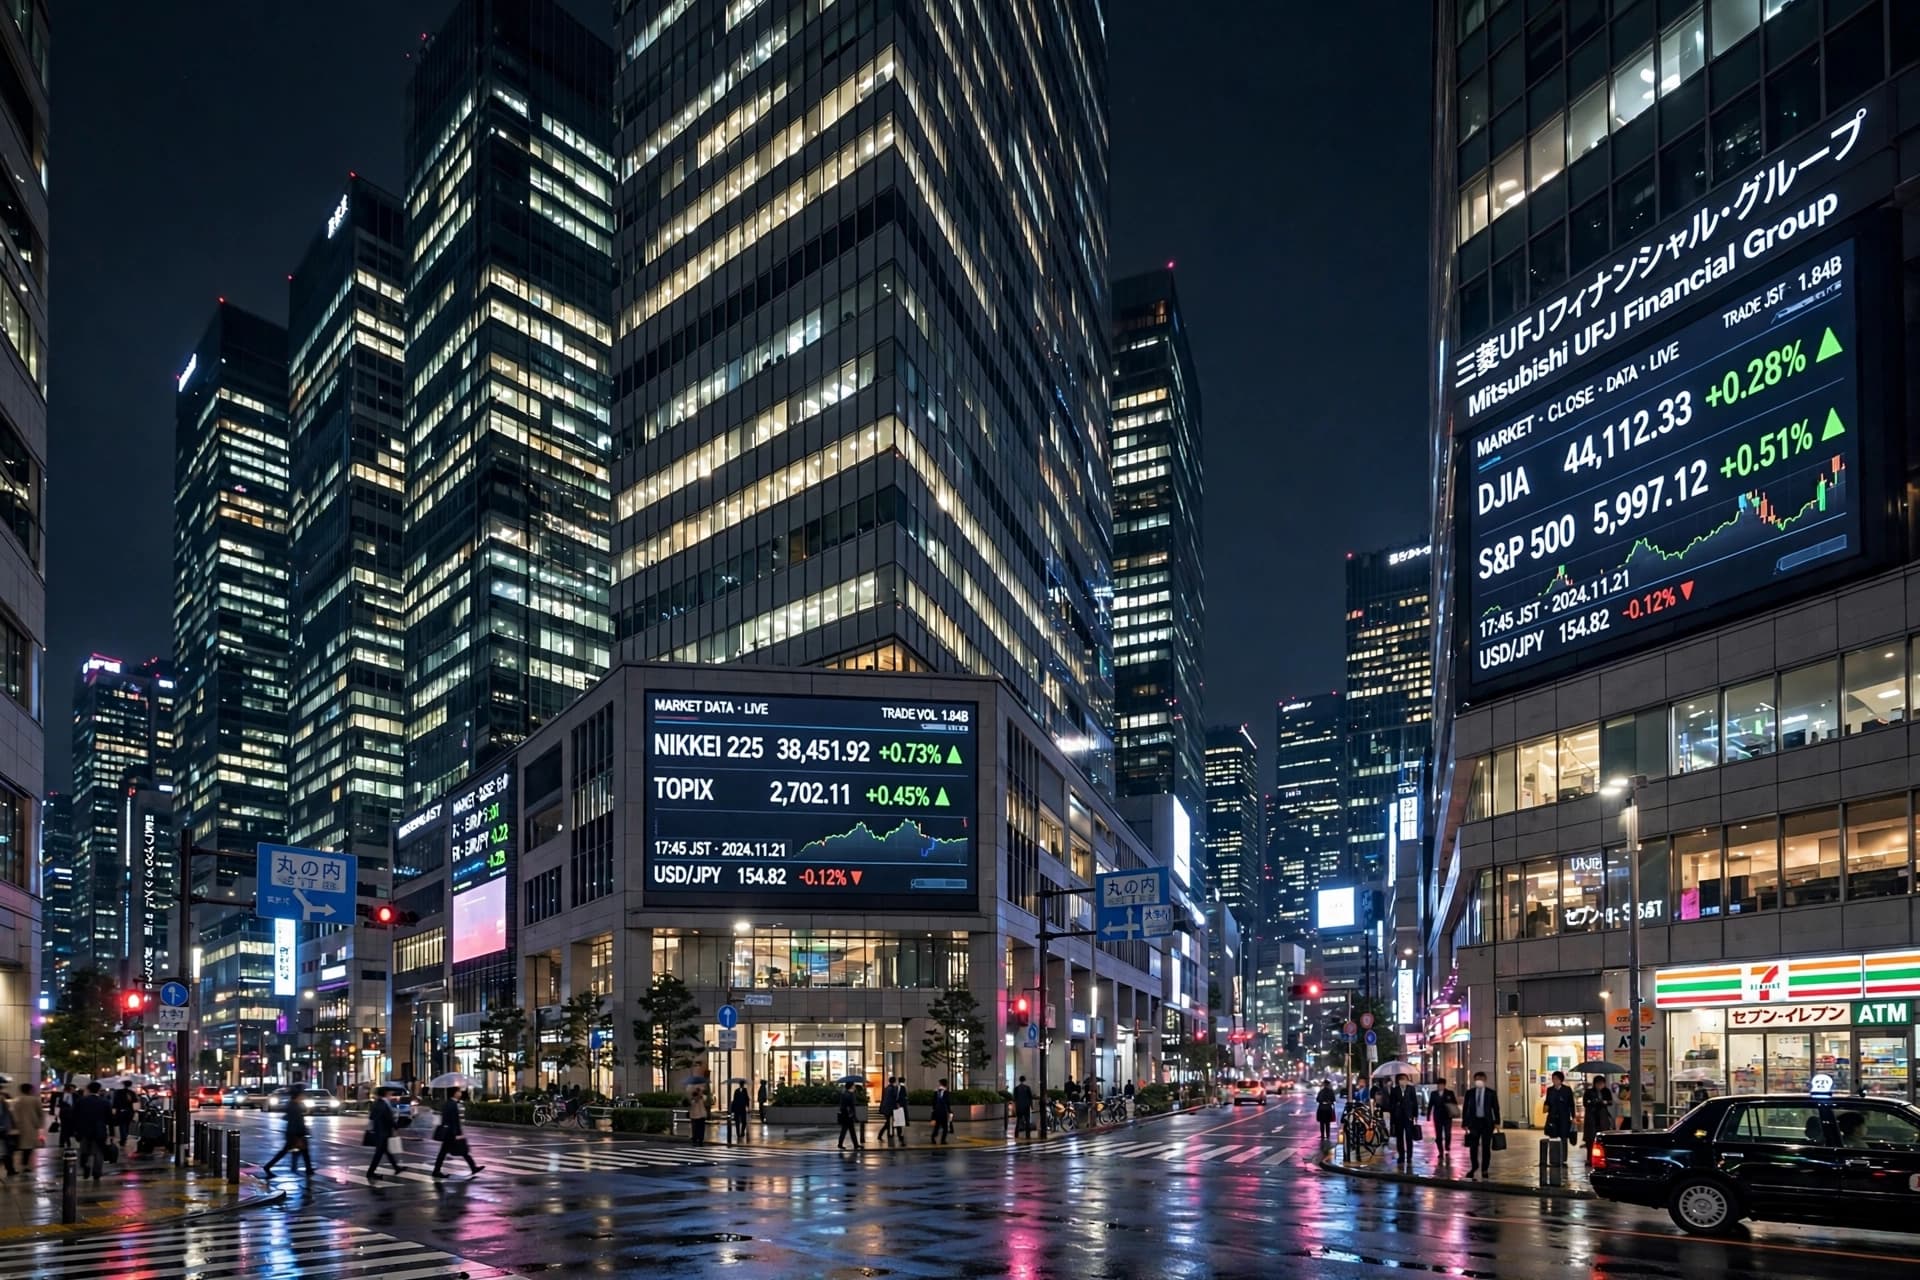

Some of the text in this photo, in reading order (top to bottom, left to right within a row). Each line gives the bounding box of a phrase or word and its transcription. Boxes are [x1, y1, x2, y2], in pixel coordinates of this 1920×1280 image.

[1455, 107, 1867, 388] 三菱UFJフィナンシャル・グループ
[1468, 192, 1838, 417] Mitsubishi UFJ Financial Group
[1722, 296, 1762, 328] TRADE
[1798, 256, 1842, 291] 1.84B
[1477, 341, 1680, 457] MARKET CLOSE DATA LIVE
[1478, 339, 1807, 516] DJIA 44,112.33 +0.28%
[1479, 418, 1813, 580] S&P 500 5,997.12 +0.51%
[1479, 586, 1677, 669] USD/JPY 154.82 -0.12%
[1480, 569, 1630, 638] 17:45 JST 2024.11.21
[655, 699, 968, 722] MARKET DATA LIVE TRADE VOL 1.84B
[654, 733, 942, 764] NIKKEI 225 38,451.92 +0.73%
[654, 777, 929, 807] TOPIX 2,702.11 +0.45%
[277, 855, 341, 881] 丸の内
[654, 841, 786, 857] 17:45 JST 2024.11.21
[654, 864, 847, 886] USD/JPY 154.82 -0.12%
[1107, 876, 1155, 896] 丸の内
[1858, 1002, 1907, 1024] ATM
